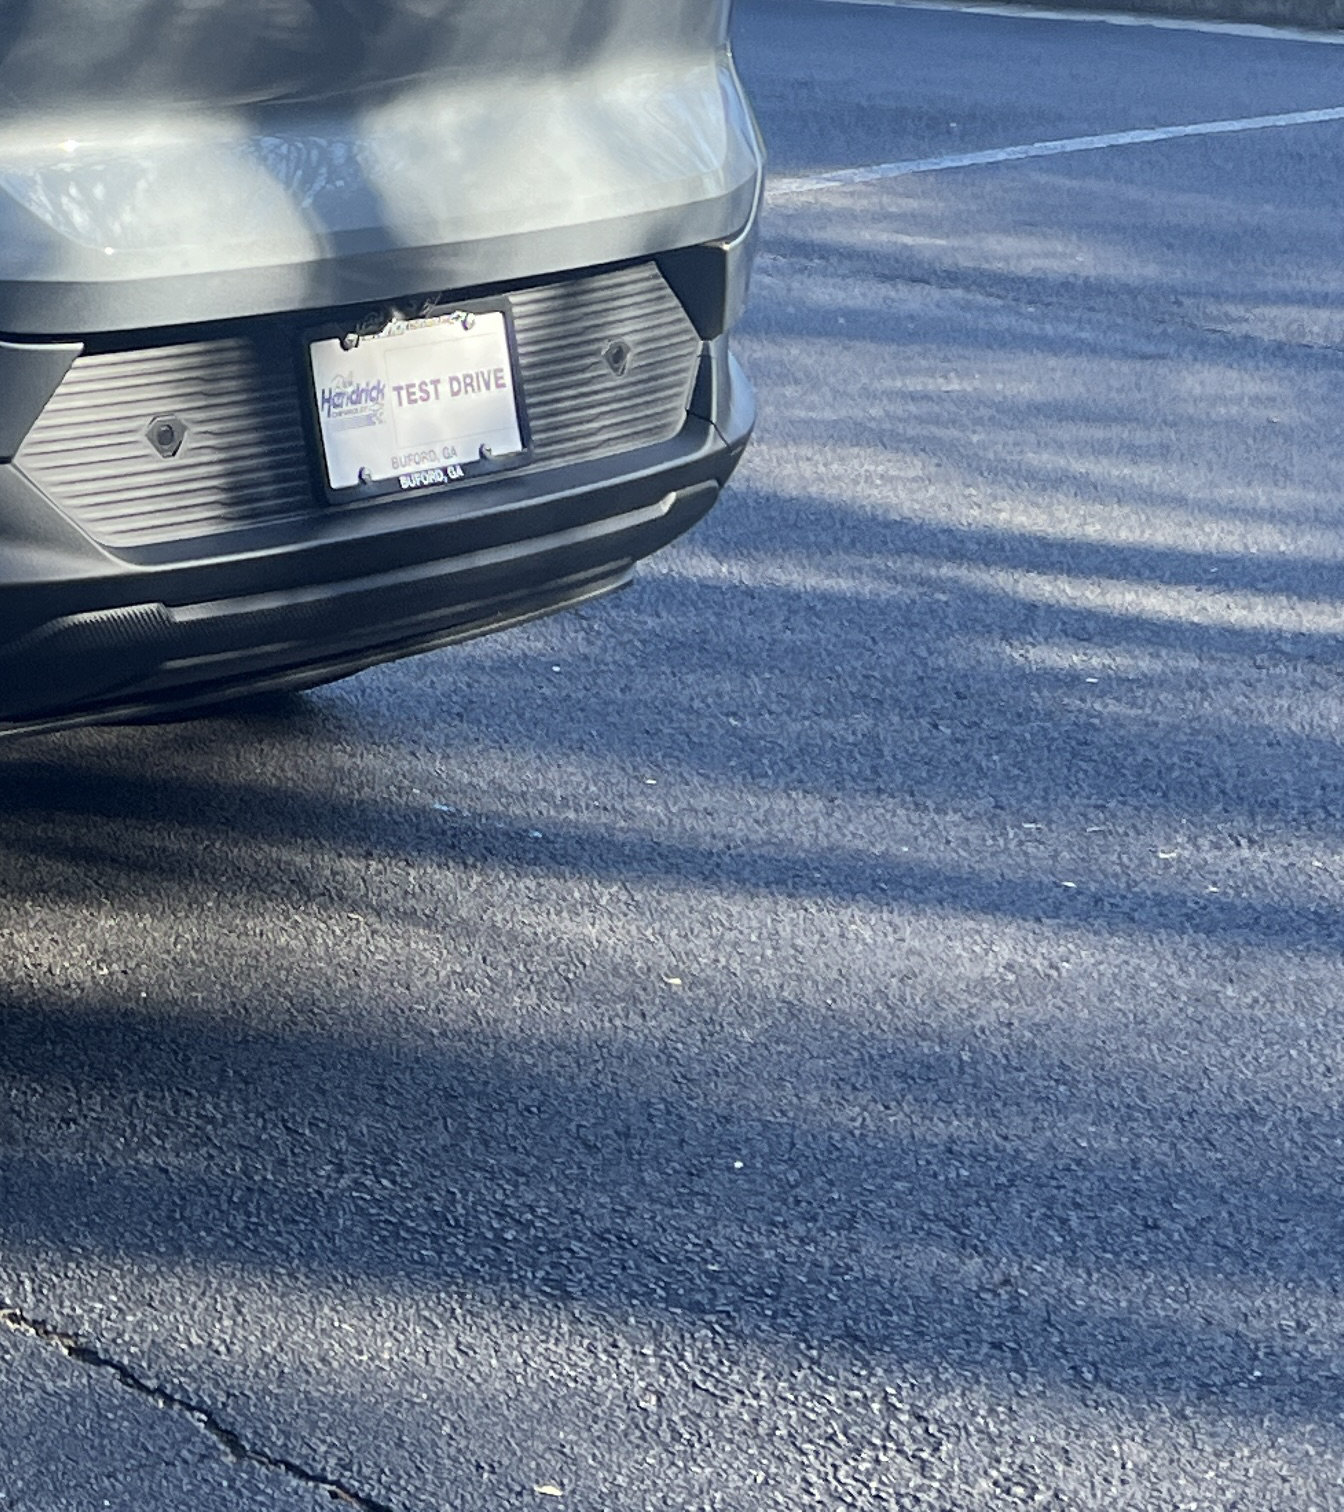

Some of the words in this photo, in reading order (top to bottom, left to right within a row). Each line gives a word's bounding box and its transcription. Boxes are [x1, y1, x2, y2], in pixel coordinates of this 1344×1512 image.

[321, 379, 386, 418] Hendrick
[392, 378, 441, 407] TEST
[448, 367, 507, 398] DRIVE
[399, 468, 448, 489] BUFORD,
[447, 464, 465, 480] GA
